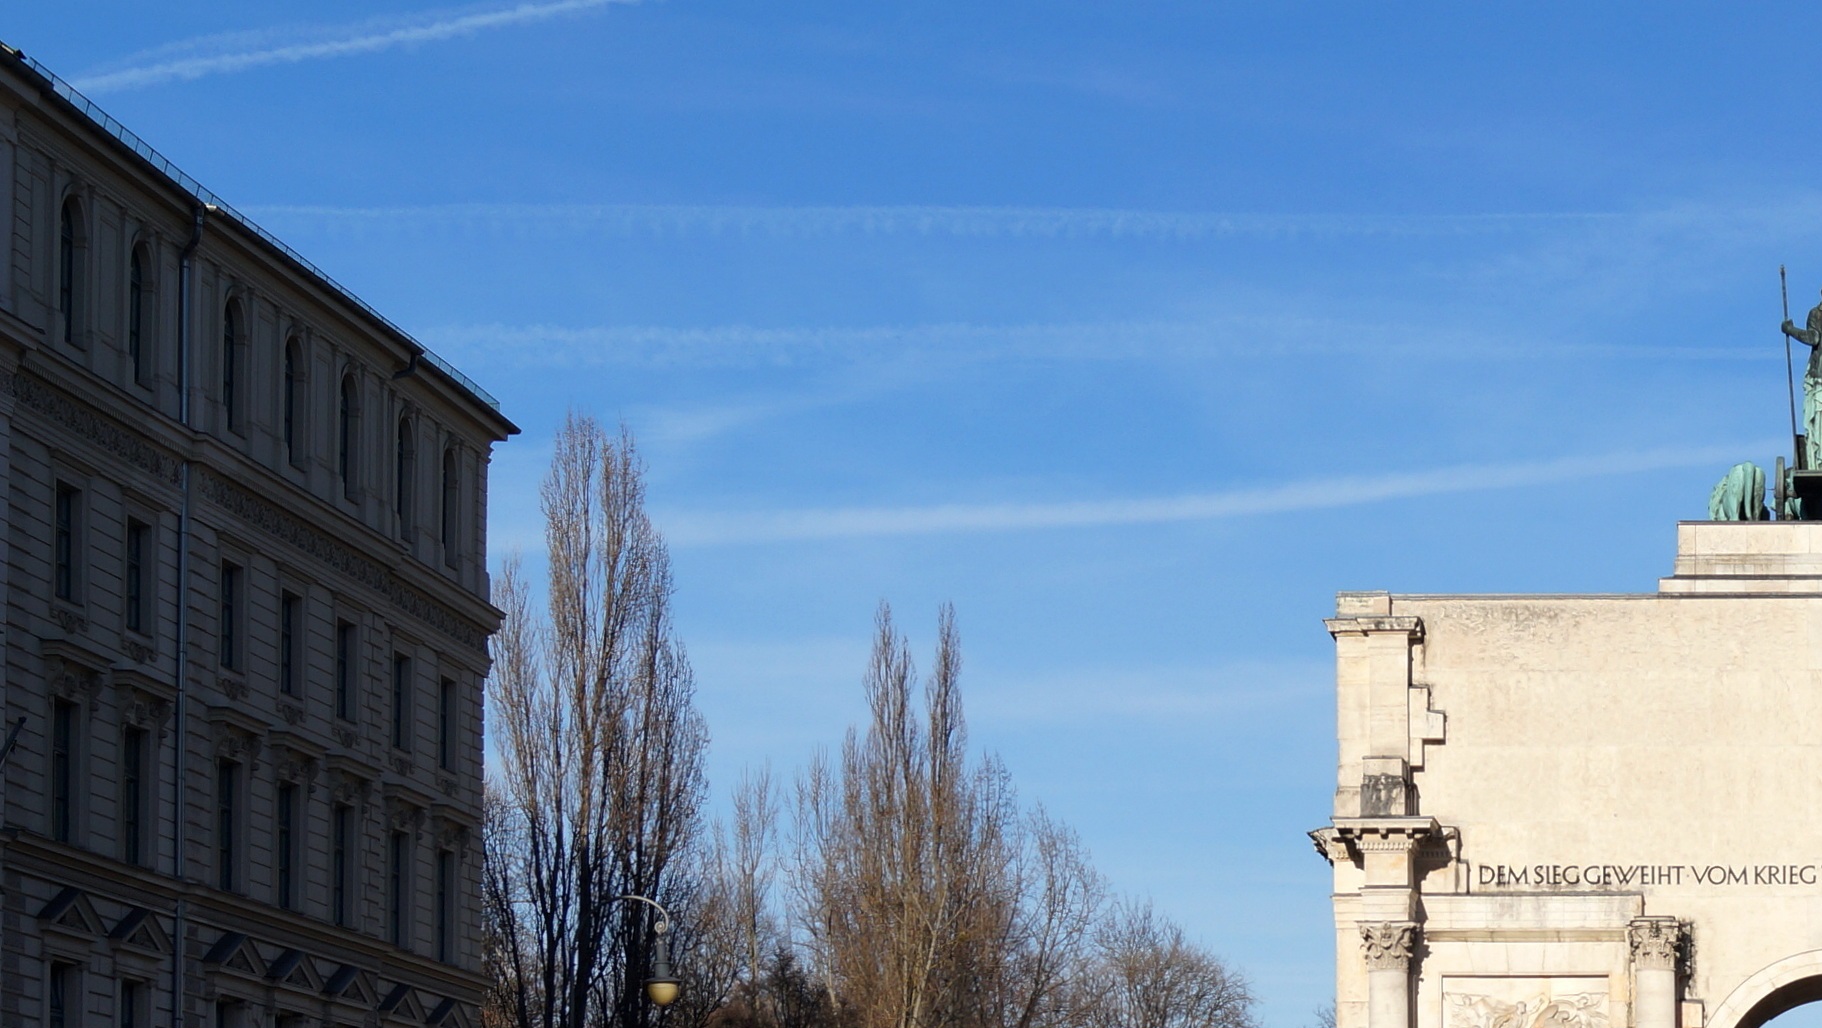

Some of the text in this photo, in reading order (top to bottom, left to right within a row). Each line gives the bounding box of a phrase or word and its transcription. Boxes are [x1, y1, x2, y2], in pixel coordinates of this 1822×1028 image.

[1479, 865, 1529, 886] DEM
[1534, 865, 1580, 886] SIEG
[1584, 865, 1685, 886] GEWEIHT
[1690, 865, 1748, 885] VOM
[1754, 865, 1817, 885] KRIEG
